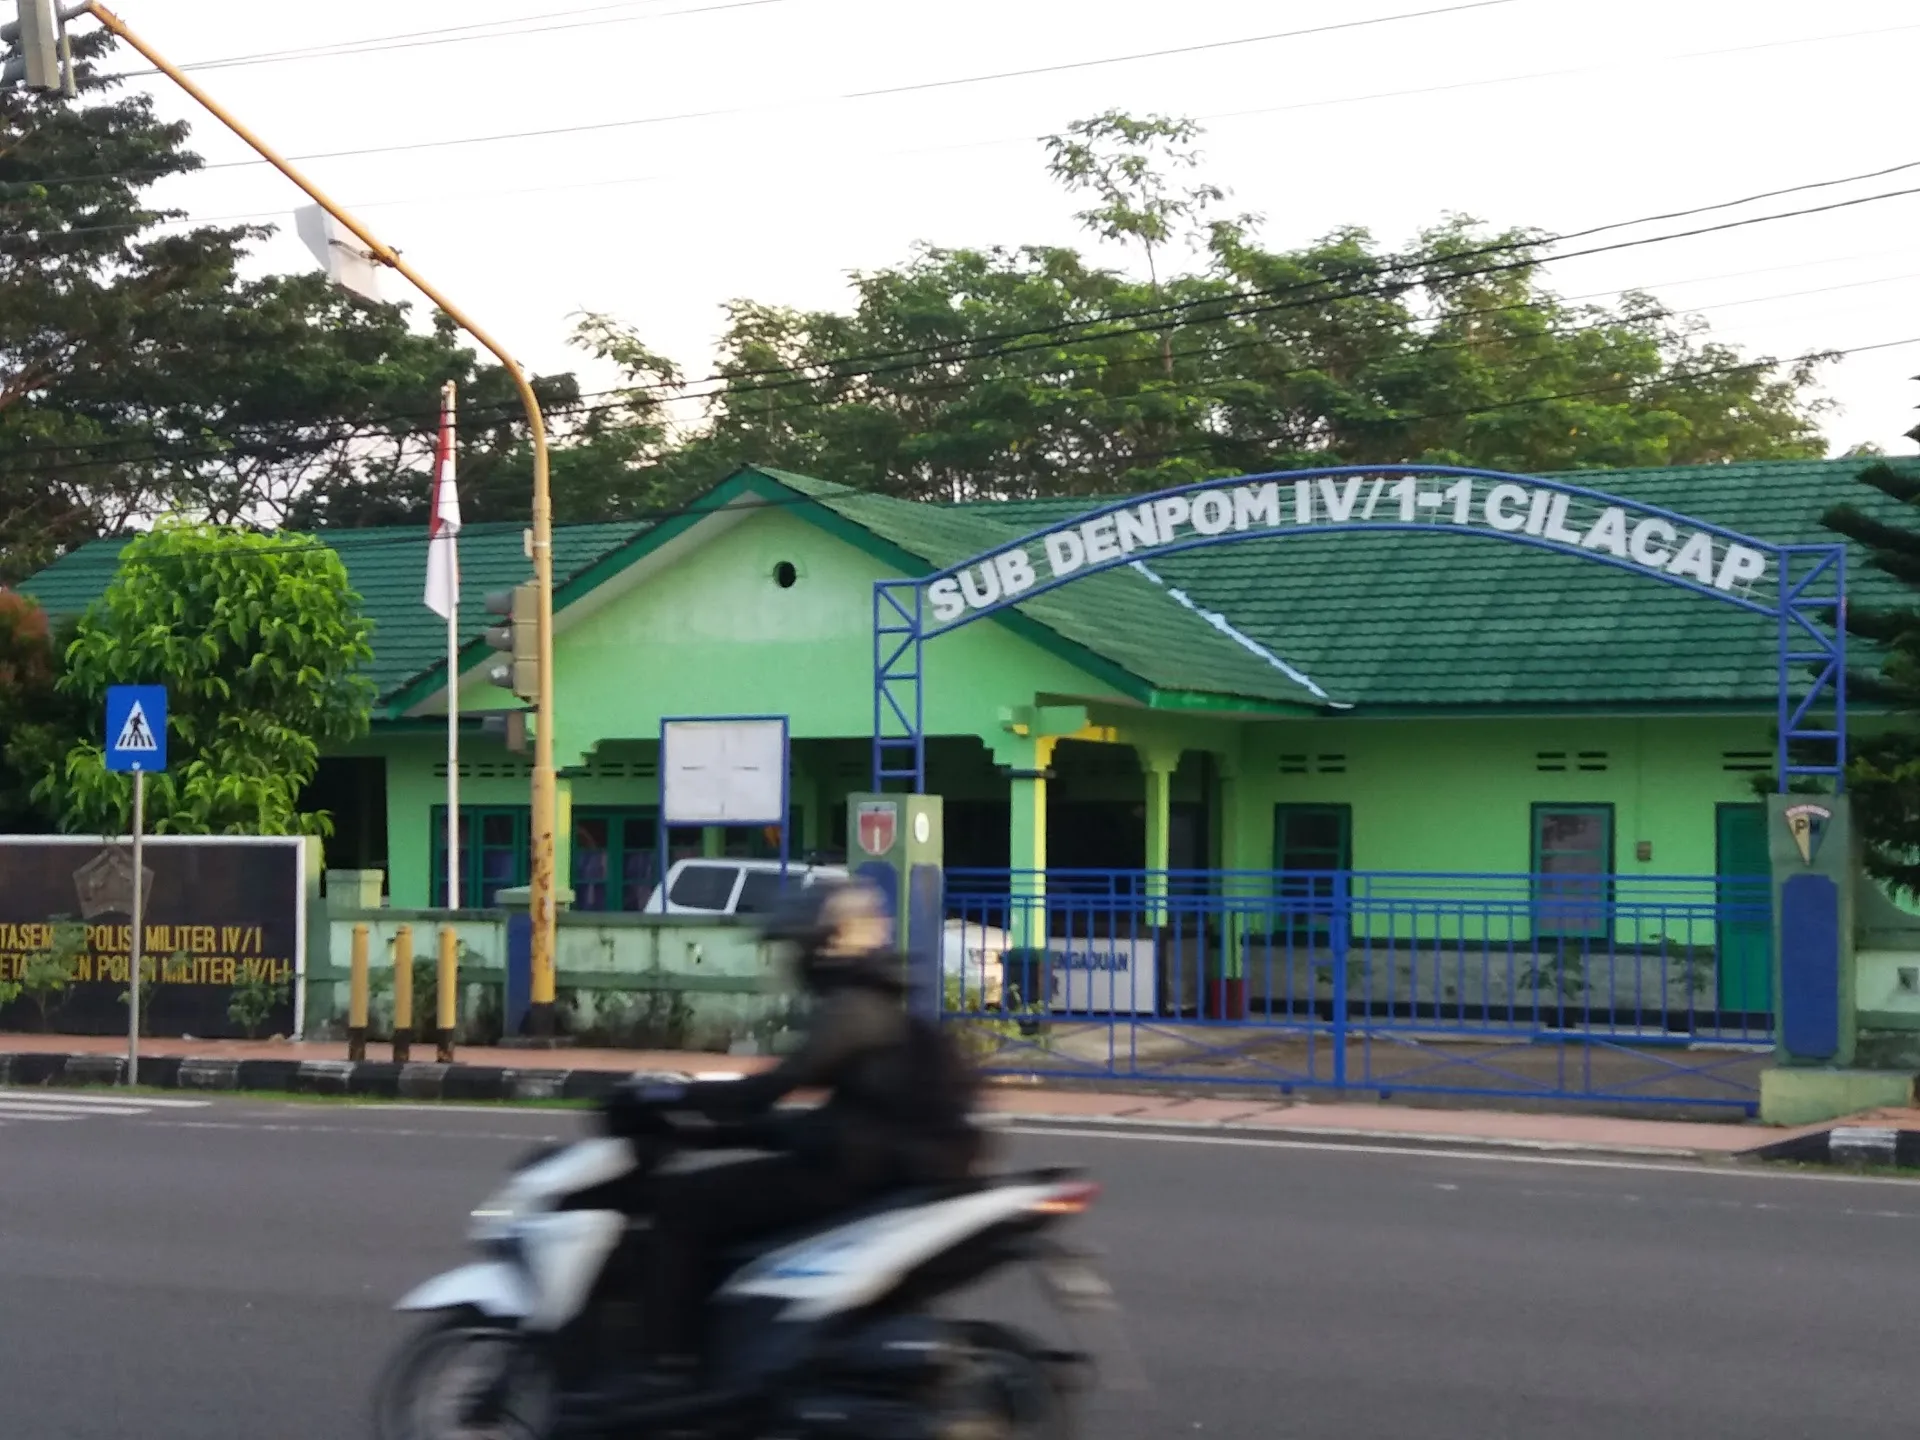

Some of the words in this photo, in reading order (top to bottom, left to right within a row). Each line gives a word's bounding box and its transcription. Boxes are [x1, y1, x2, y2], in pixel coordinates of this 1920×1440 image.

[927, 548, 1036, 622] SUB
[1044, 481, 1280, 577] DENPOM
[1295, 475, 1473, 525] IV/1-1
[1485, 483, 1766, 591] CILACAP
[84, 924, 138, 952] POLIS
[145, 925, 217, 953] MILITER
[97, 954, 156, 983] POLI
